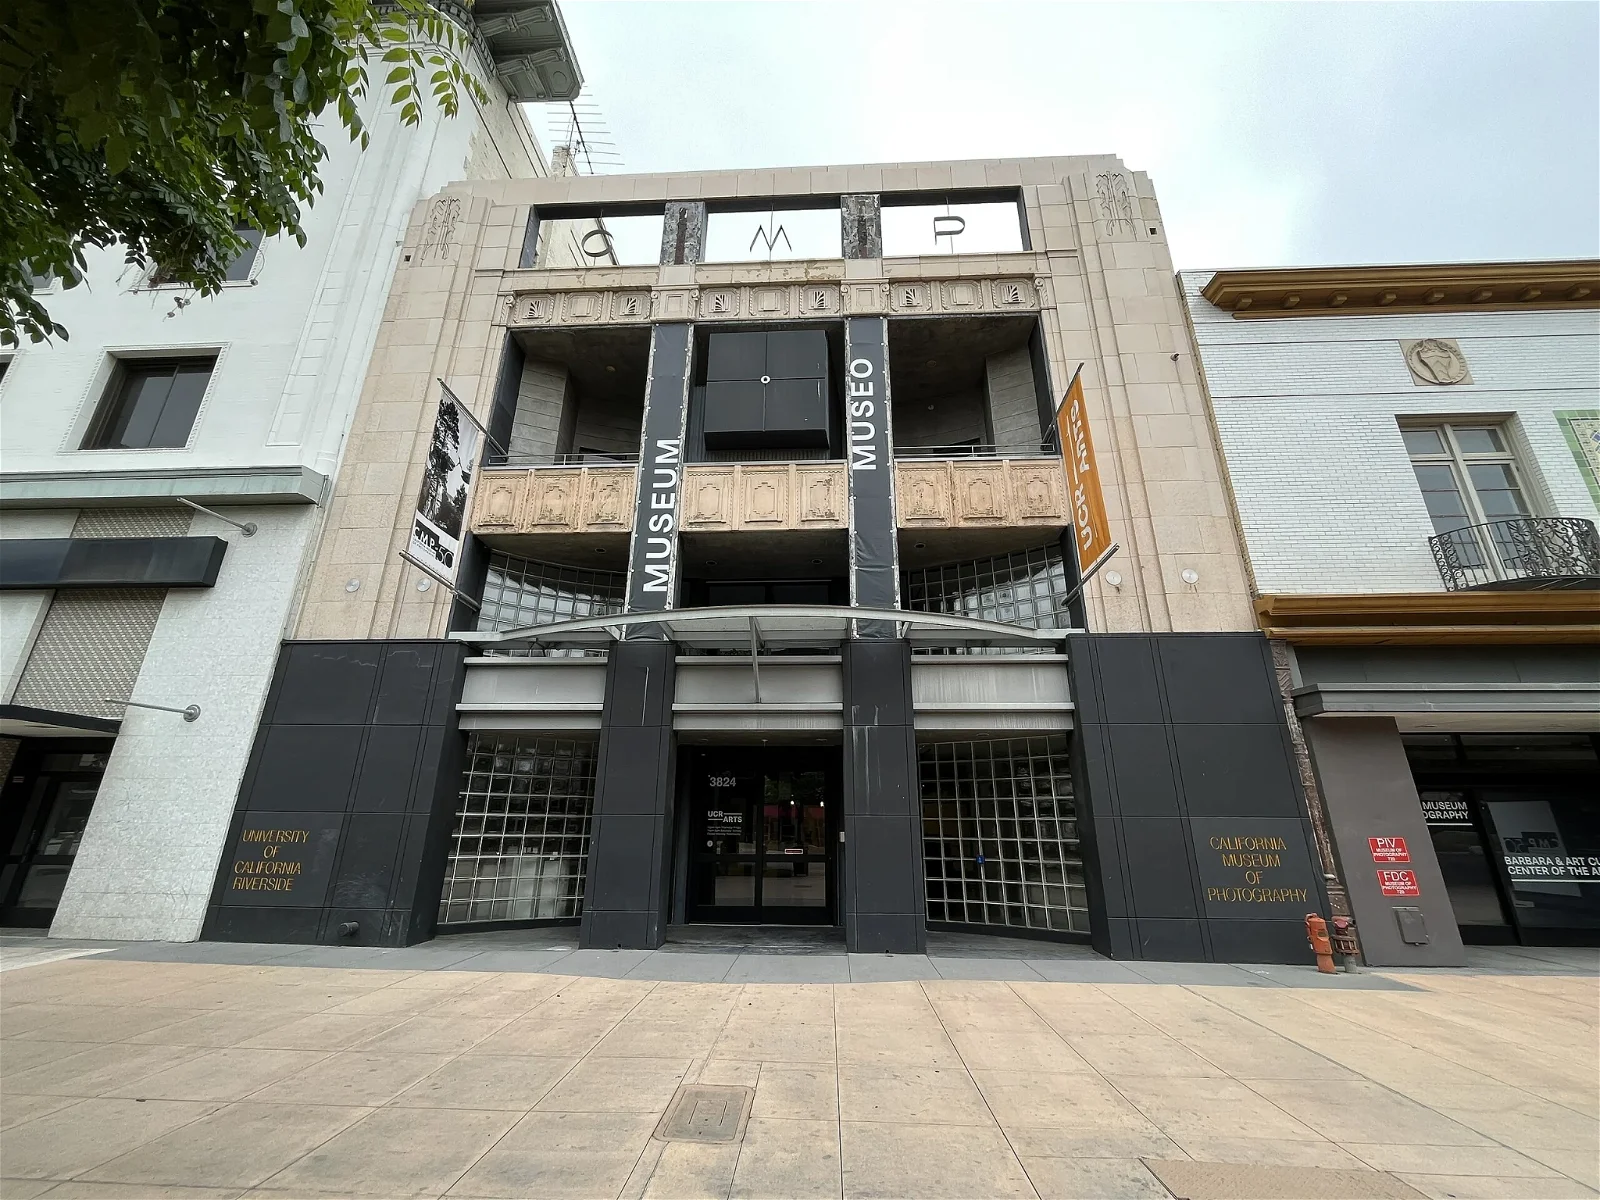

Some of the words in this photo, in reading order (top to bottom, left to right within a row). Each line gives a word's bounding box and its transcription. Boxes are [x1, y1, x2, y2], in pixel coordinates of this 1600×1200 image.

[849, 358, 877, 470] MUSEO
[643, 438, 680, 592] MUSEUM
[1074, 482, 1093, 551] UCR
[710, 777, 736, 787] 3824
[1422, 801, 1468, 810] MUSEUM
[243, 829, 310, 843] UNIVERSITY
[1376, 838, 1396, 848] PIV
[1210, 836, 1287, 851] CALIFORNIA
[263, 845, 281, 859] OF
[234, 861, 301, 874] CALIFORNIA
[1222, 854, 1281, 868] MUSEUM
[1504, 856, 1552, 866] BARBARA
[1555, 857, 1565, 866] &
[1565, 857, 1585, 866] ART
[1245, 871, 1263, 885] OF
[1384, 871, 1409, 881] FDC
[1507, 866, 1550, 876] CENTER
[1550, 866, 1567, 876] OF
[1567, 866, 1590, 876] THE
[232, 877, 294, 891] RIVERSIDE
[1207, 887, 1307, 902] PHOTOGRAPHY
